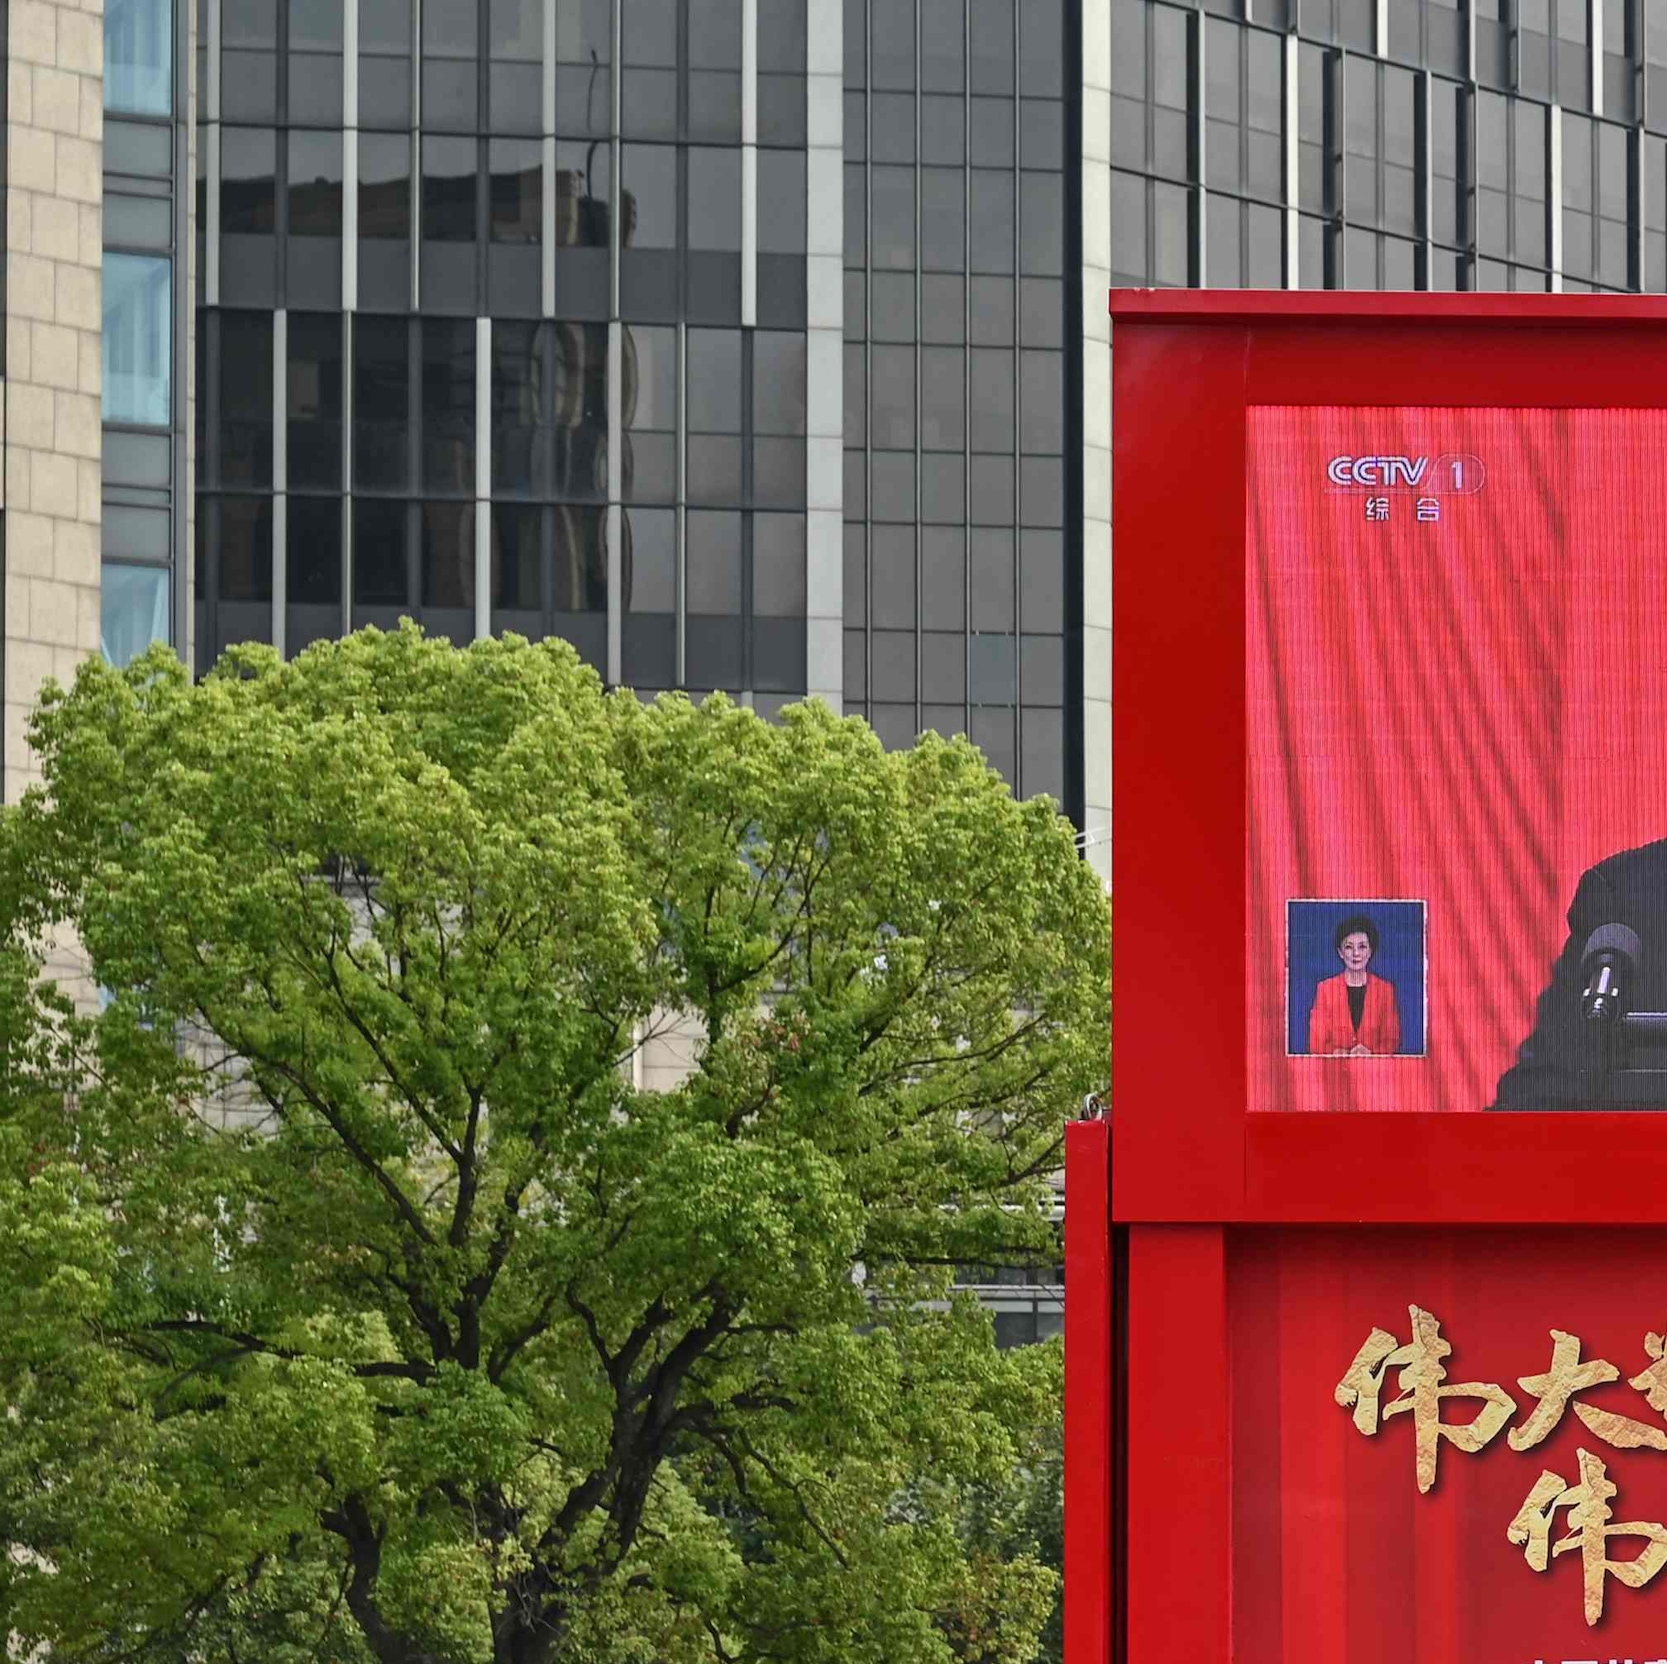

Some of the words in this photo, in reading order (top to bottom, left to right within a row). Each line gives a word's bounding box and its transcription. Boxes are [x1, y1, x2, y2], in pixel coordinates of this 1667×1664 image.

[1328, 456, 1428, 486] CCTV
[1451, 462, 1463, 490] 1
[1365, 496, 1440, 521] 综合
